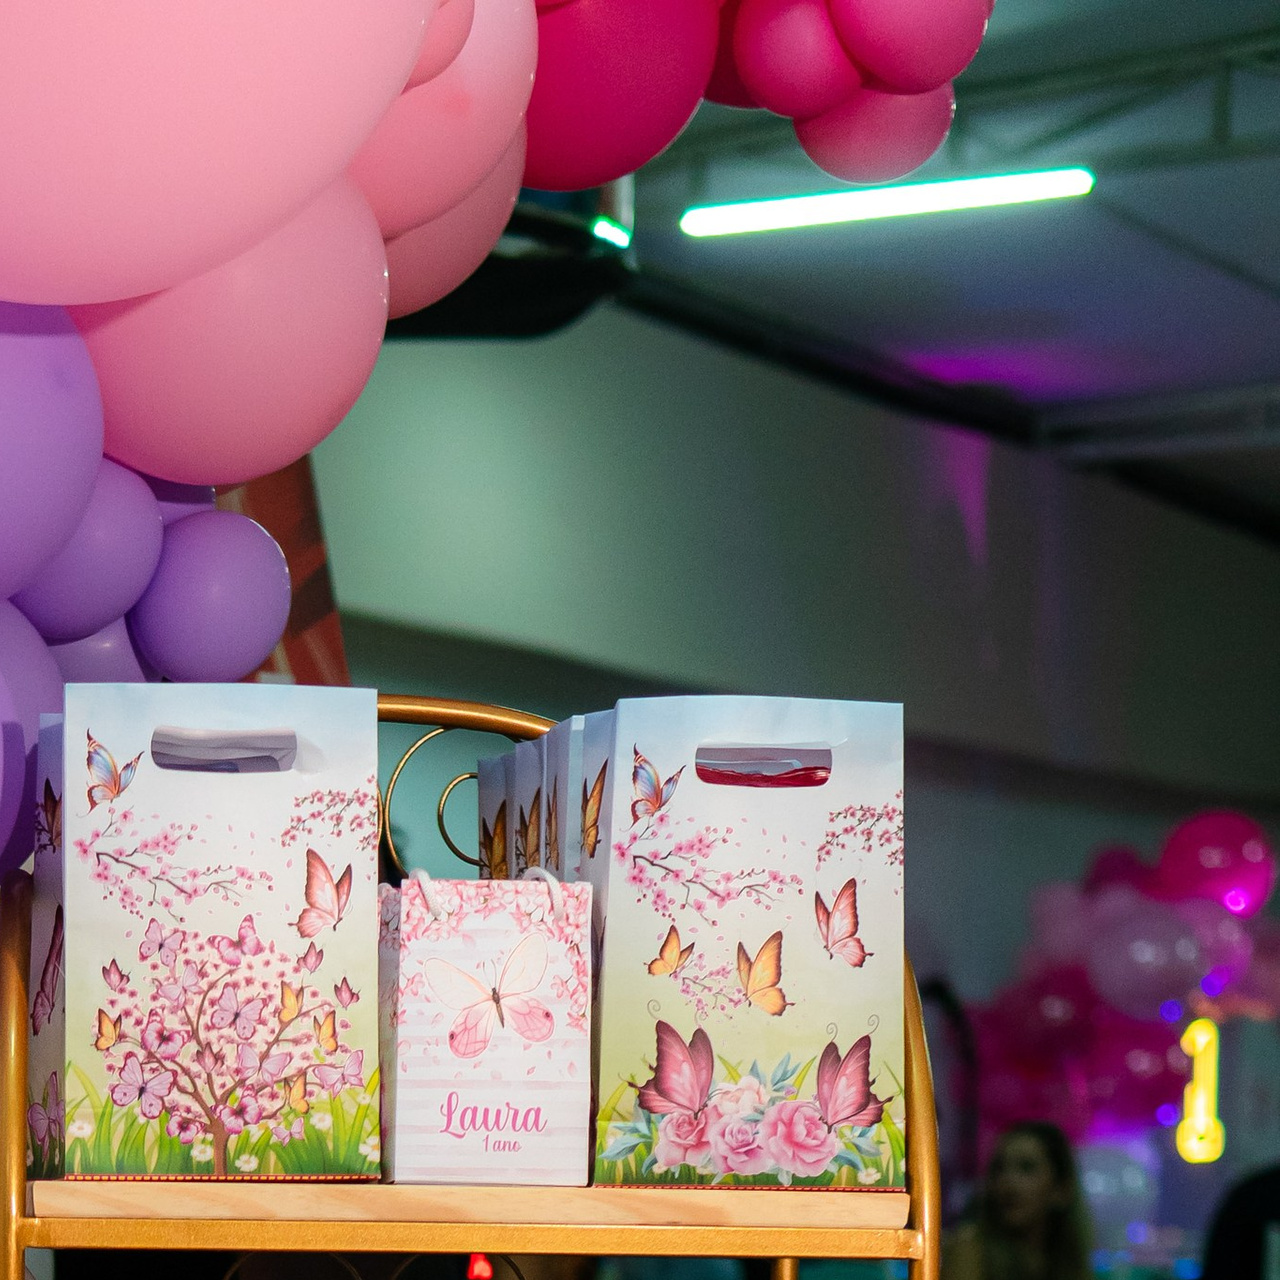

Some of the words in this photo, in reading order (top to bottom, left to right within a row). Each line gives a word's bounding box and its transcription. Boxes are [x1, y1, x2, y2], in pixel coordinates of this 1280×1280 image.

[439, 1091, 548, 1139] Laura
[482, 1134, 490, 1152] 1
[492, 1140, 522, 1152] ano
